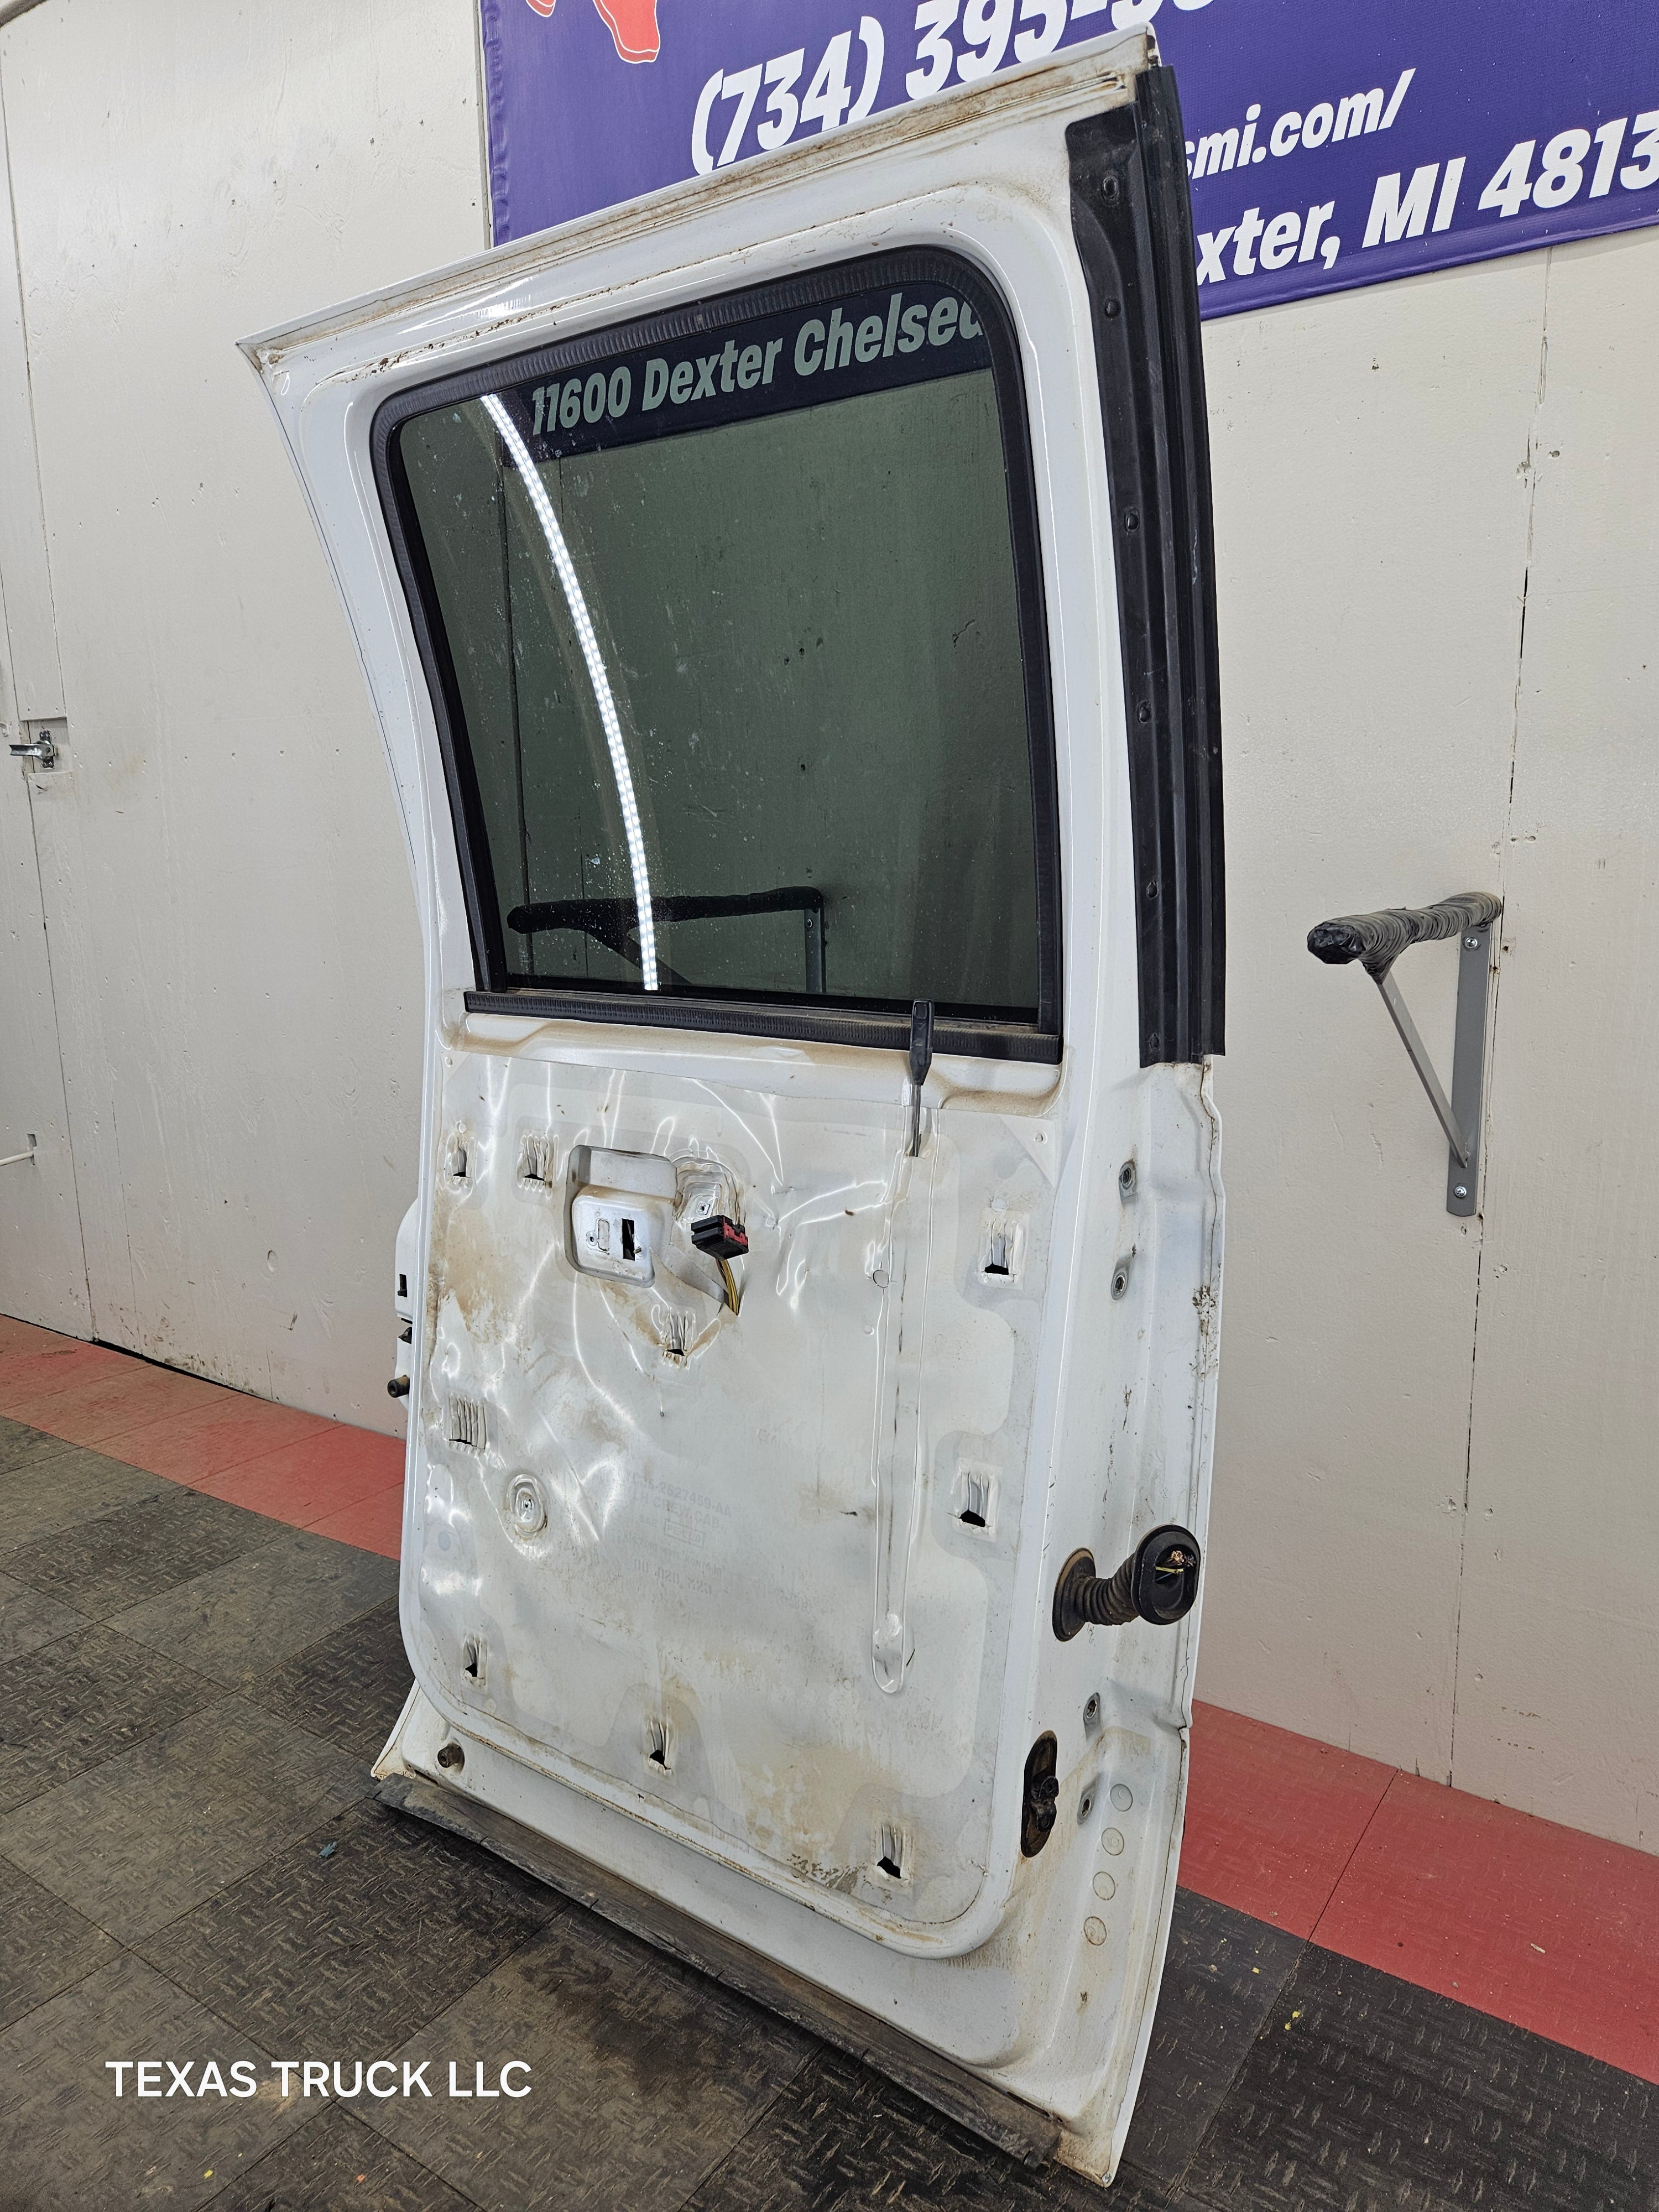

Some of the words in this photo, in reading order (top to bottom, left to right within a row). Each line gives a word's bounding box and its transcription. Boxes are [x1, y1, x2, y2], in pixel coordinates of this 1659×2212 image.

[691, 15, 884, 176] (734)
[905, 0, 1215, 100] 395-
[531, 366, 631, 436] 11600
[641, 337, 783, 411] Dexter
[1362, 156, 1466, 249] MI
